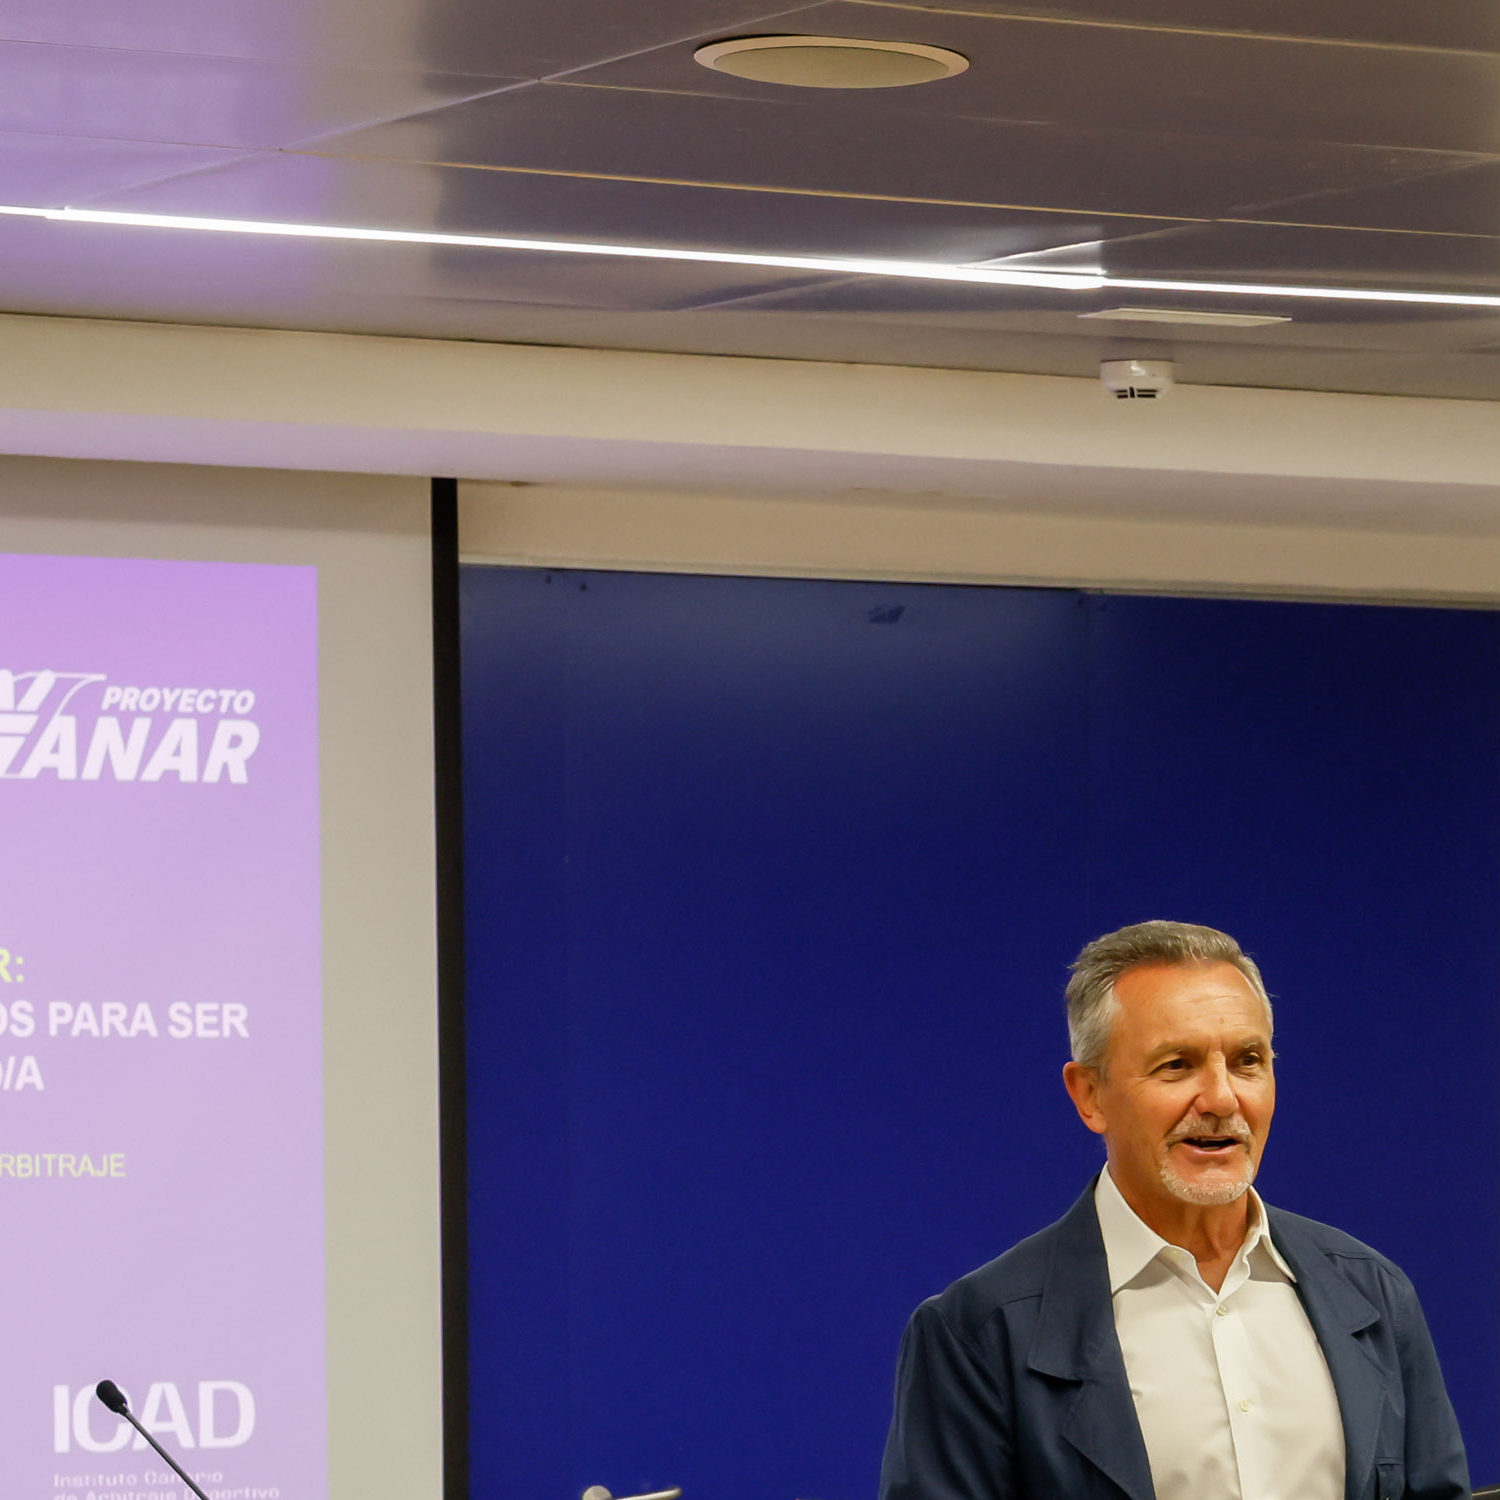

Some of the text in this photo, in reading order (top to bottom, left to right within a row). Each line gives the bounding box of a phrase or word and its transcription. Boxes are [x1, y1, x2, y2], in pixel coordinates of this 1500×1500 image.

[101, 685, 256, 715] PROYECTO
[48, 1002, 158, 1038] PARA
[167, 1002, 250, 1039] SER
[53, 1380, 257, 1454] ICAD
[53, 1470, 223, 1489] Instituto Canrio
